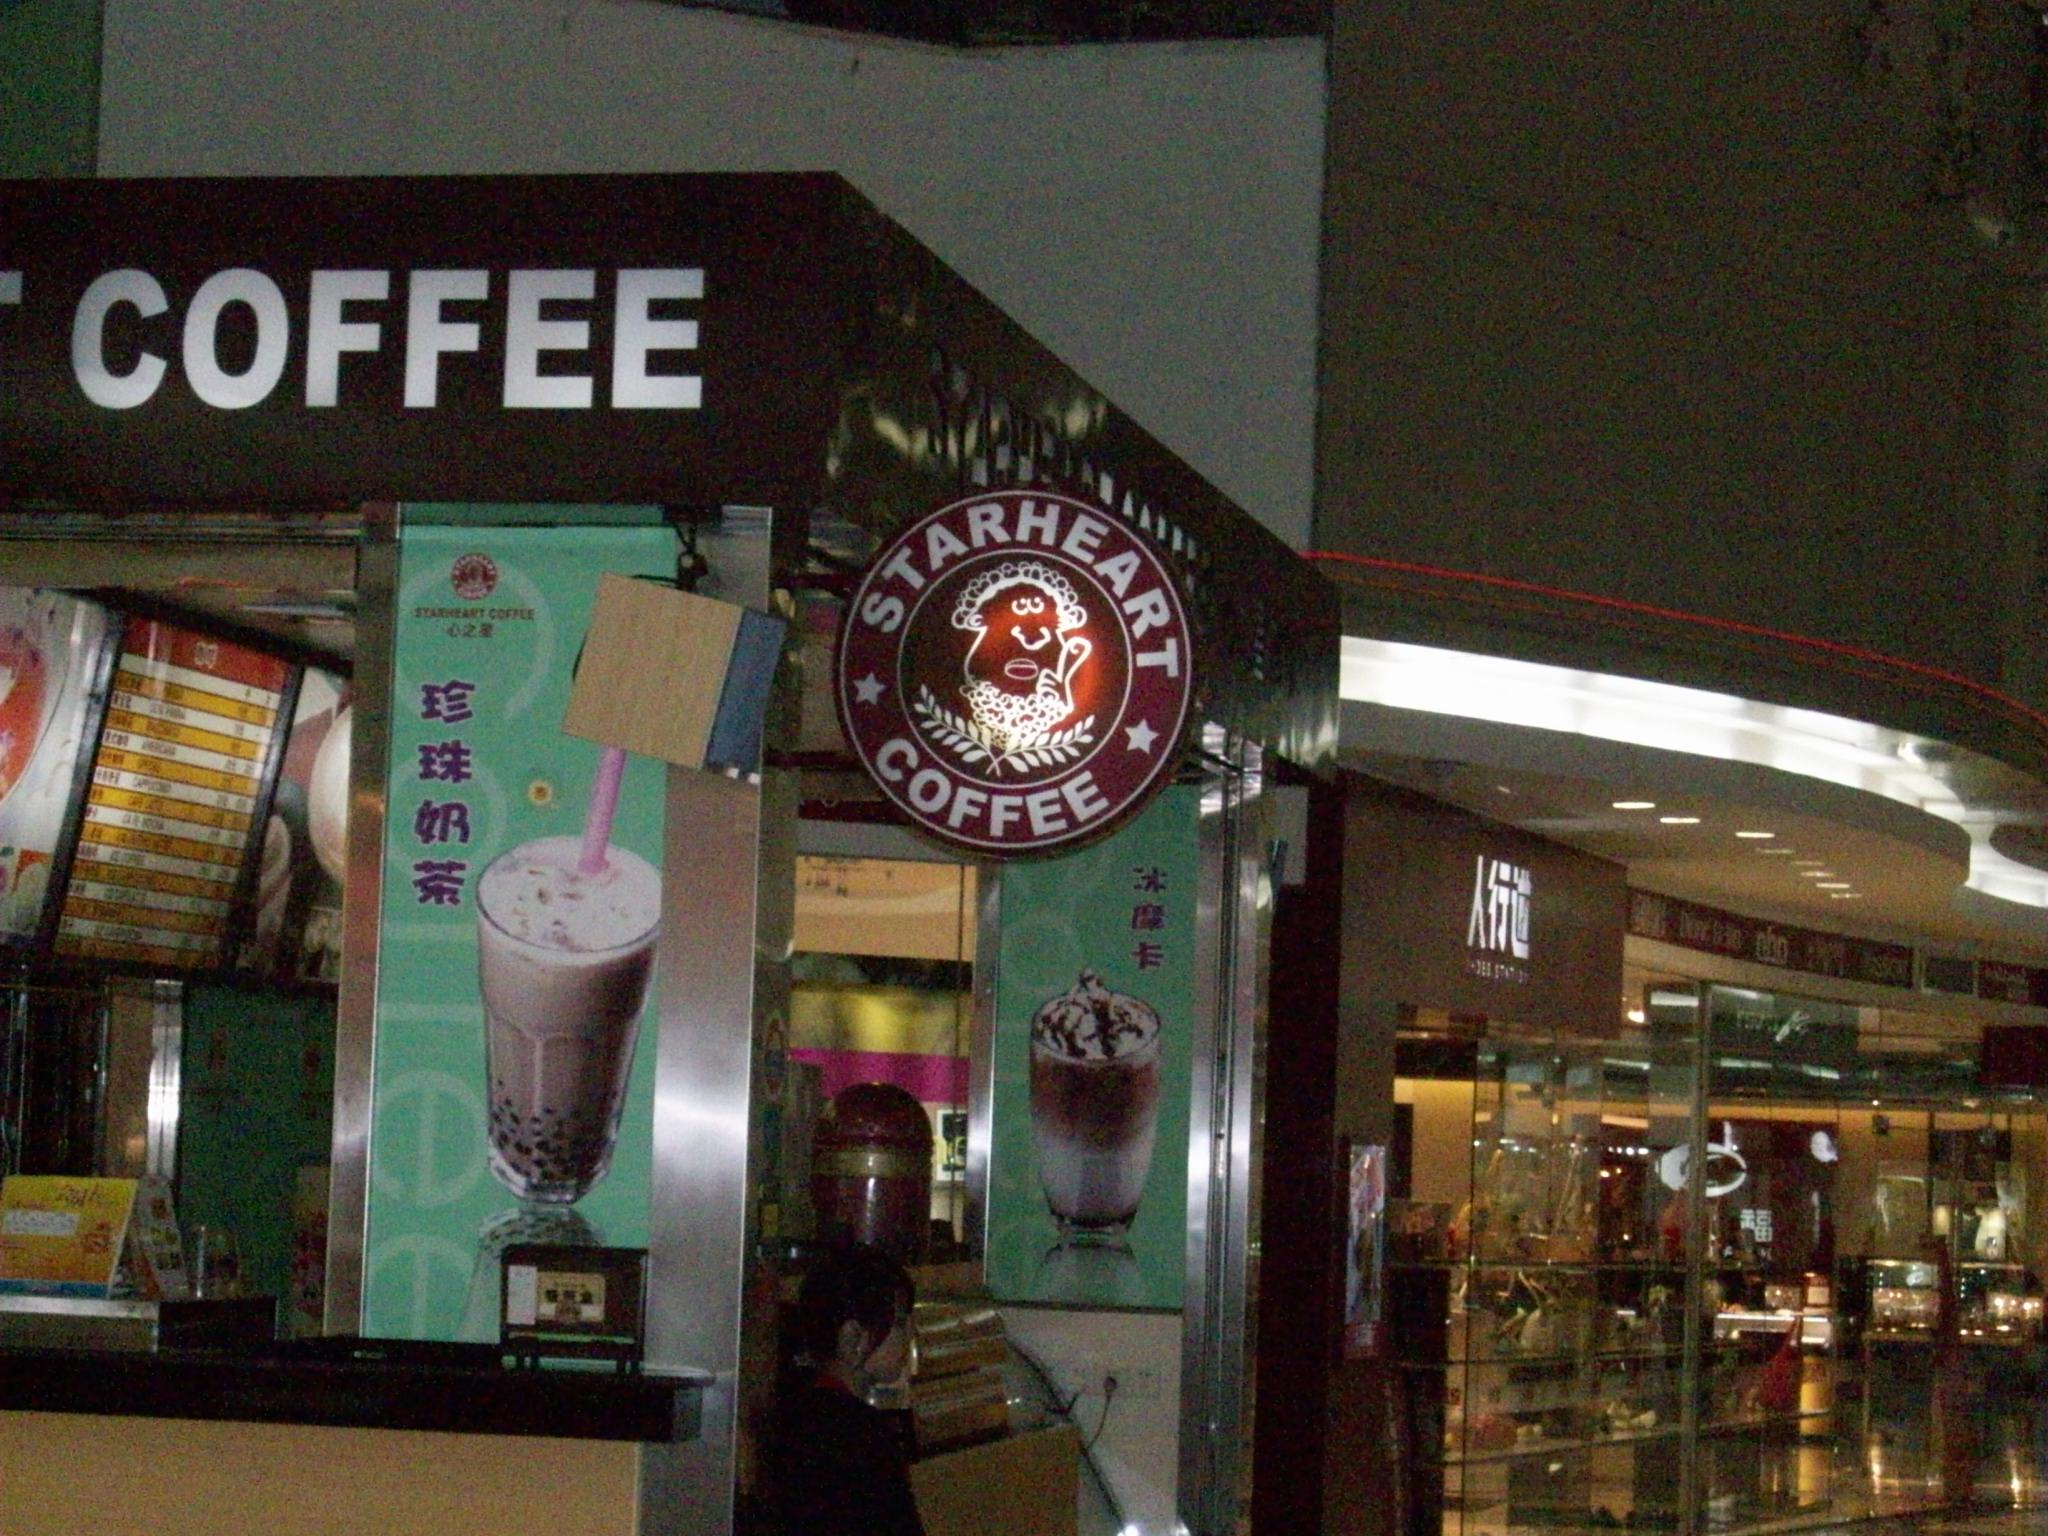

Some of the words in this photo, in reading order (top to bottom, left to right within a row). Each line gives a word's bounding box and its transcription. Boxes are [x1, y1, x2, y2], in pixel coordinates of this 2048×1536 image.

[71, 268, 705, 409] COFFEE
[488, 608, 535, 620] COFFEE
[862, 500, 1179, 679] STARHEART
[413, 680, 475, 905] 珍珠奶茶
[876, 738, 1107, 837] COFFEE
[1467, 855, 1531, 959] 人行道
